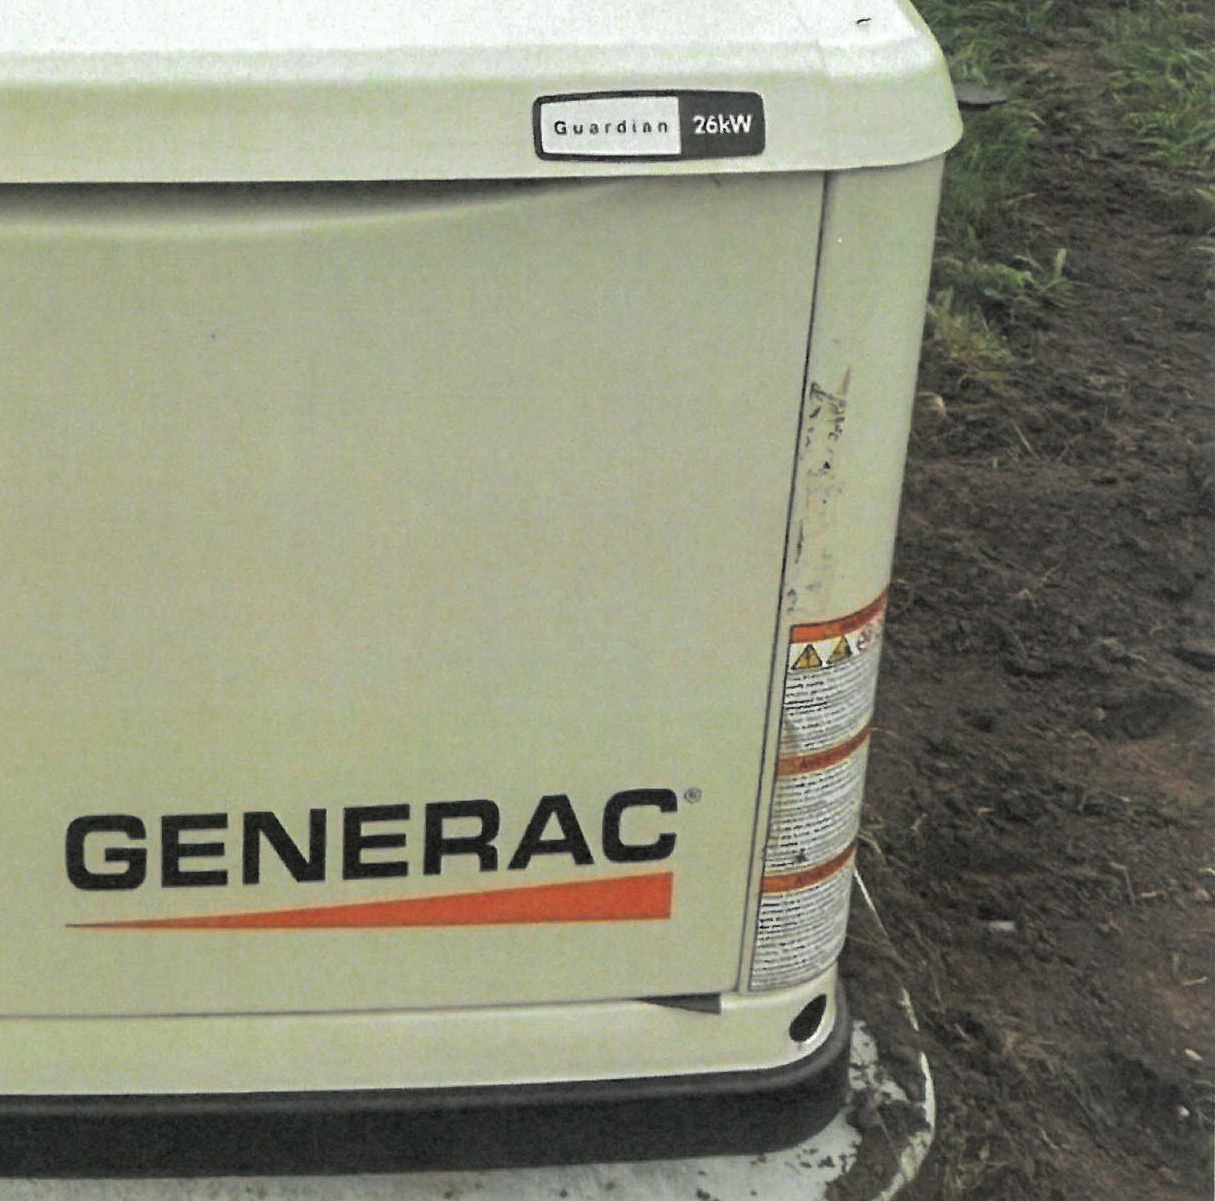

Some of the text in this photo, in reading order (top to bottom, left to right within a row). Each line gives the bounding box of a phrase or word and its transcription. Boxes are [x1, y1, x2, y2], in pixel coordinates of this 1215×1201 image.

[554, 113, 753, 135] Guardian 26kW
[65, 787, 678, 892] GENERAC
